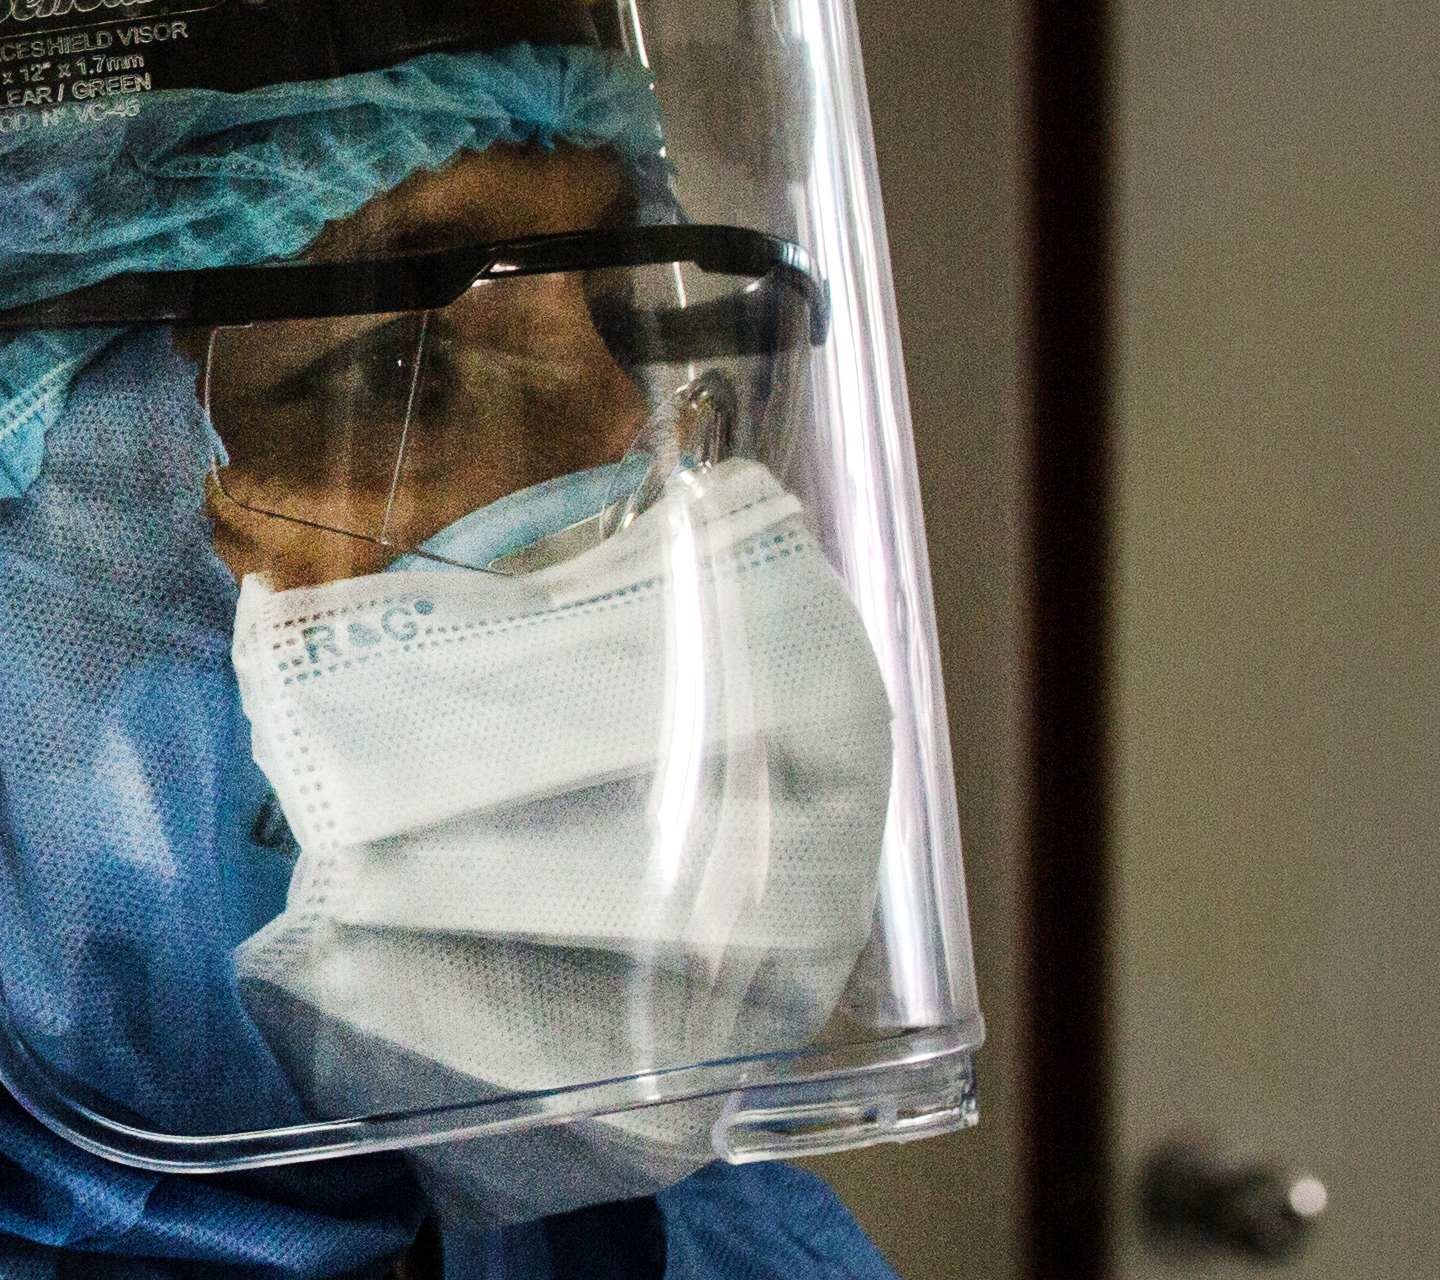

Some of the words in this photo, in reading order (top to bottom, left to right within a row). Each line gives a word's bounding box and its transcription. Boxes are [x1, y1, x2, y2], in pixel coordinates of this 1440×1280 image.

[119, 20, 190, 48] VISOR
[56, 82, 65, 103] /
[70, 73, 153, 100] GREEN
